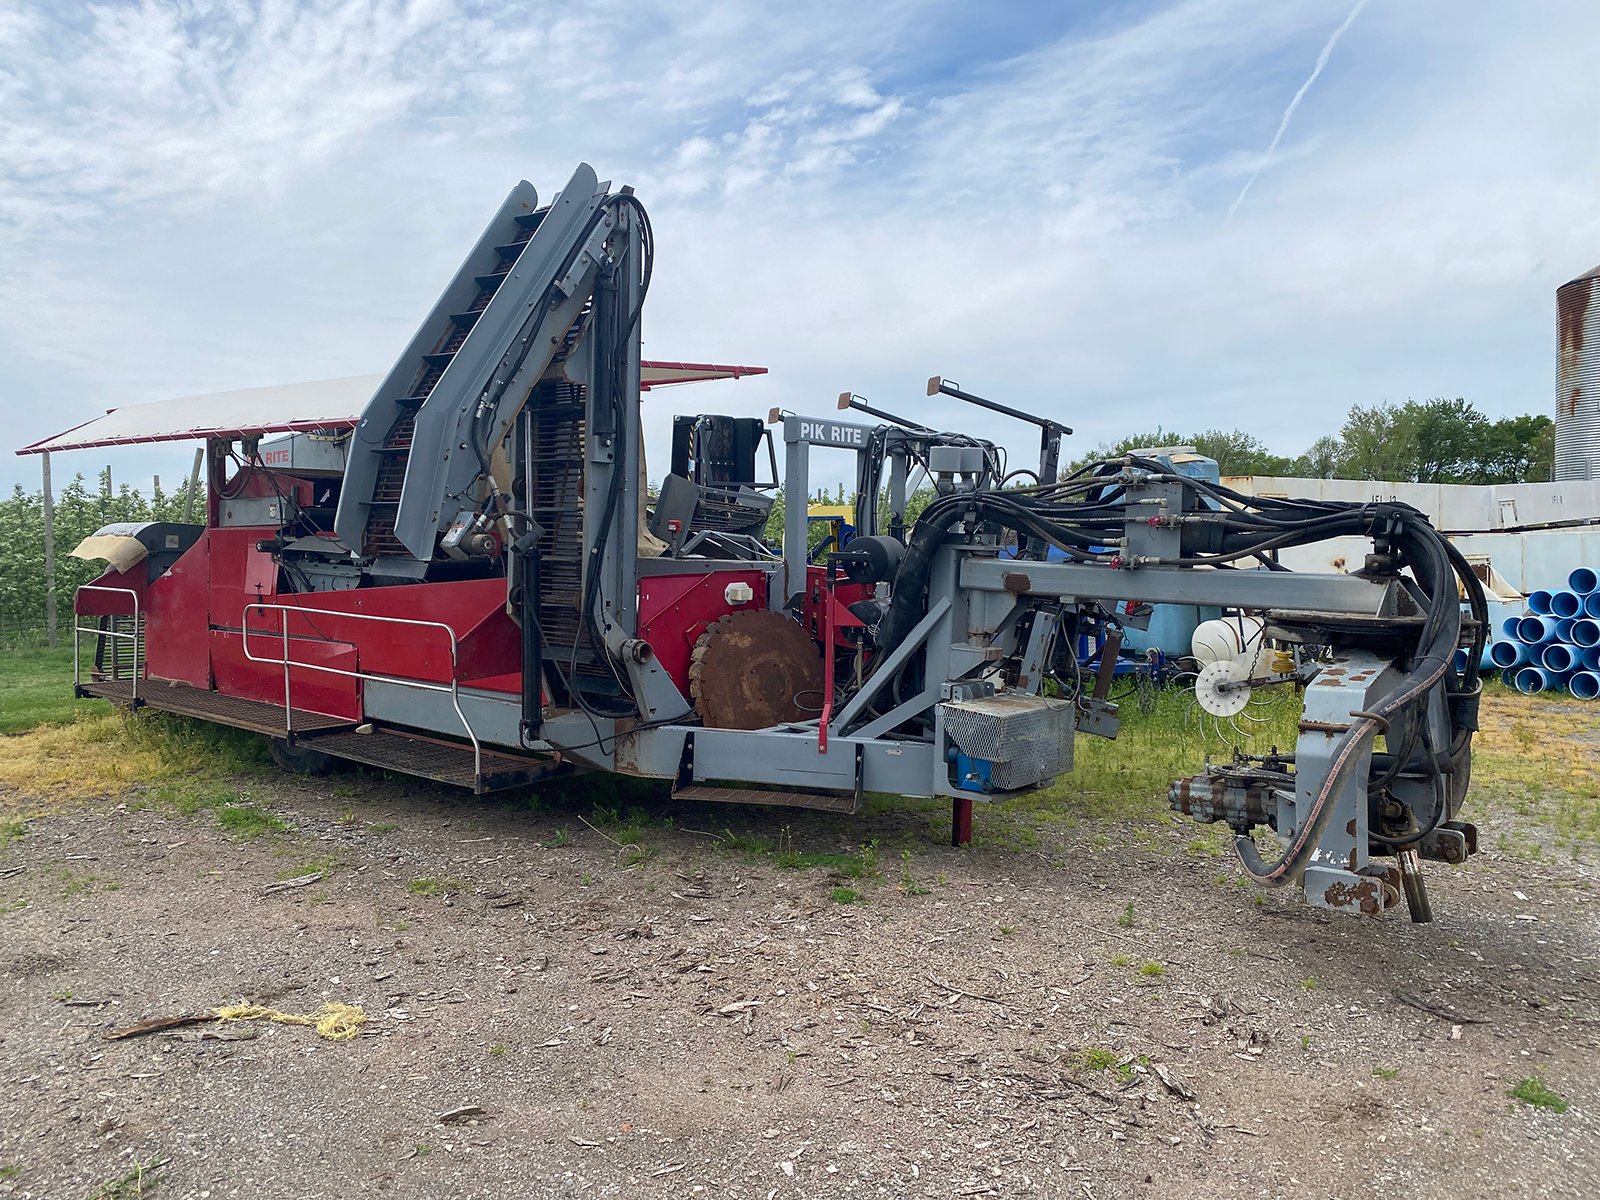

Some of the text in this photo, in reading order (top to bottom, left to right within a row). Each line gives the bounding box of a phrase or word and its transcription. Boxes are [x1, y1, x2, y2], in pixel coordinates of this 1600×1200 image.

[800, 422, 862, 443] PIK RITE
[265, 449, 289, 464] RITE
